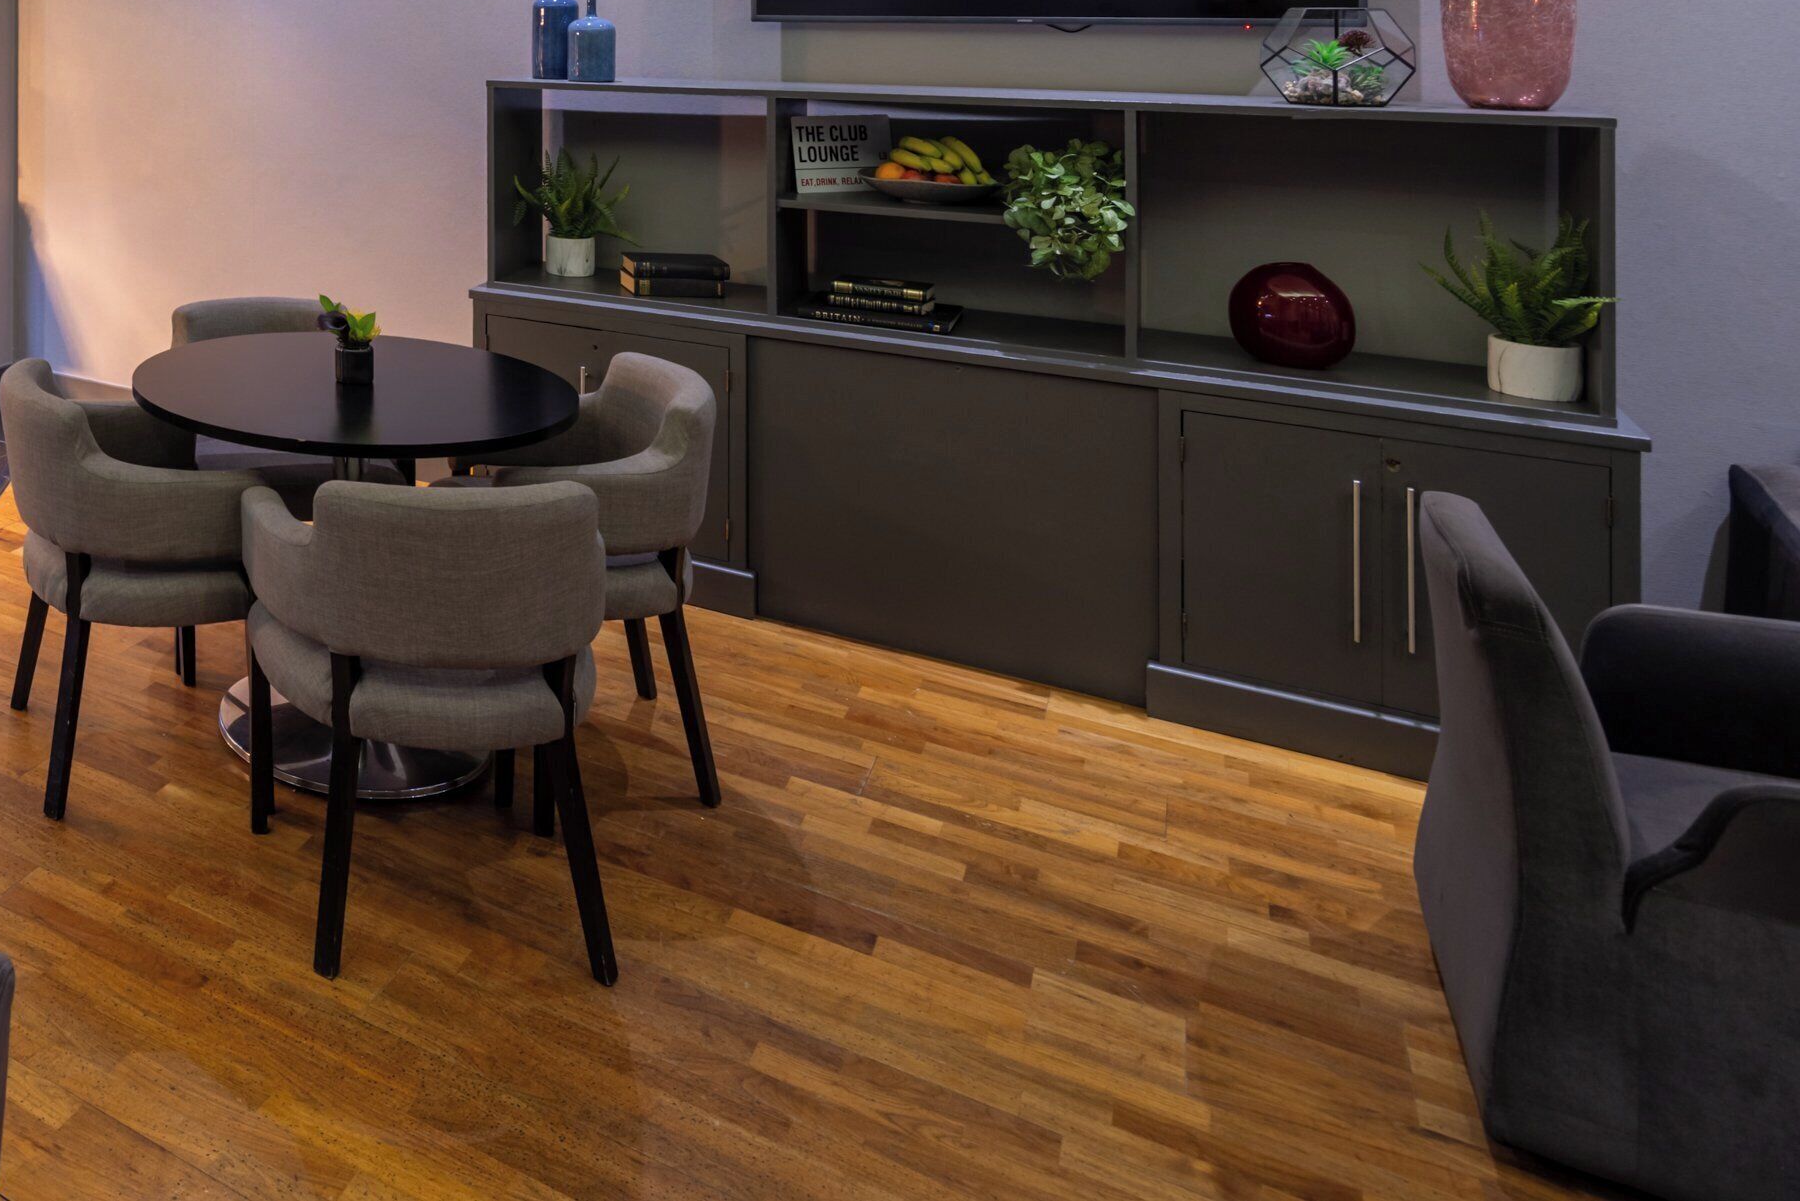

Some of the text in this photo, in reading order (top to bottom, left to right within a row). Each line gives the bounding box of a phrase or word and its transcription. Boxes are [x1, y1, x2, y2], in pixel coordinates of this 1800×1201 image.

[796, 124, 868, 142] THE CLUB
[798, 145, 859, 163] LOUNGE
